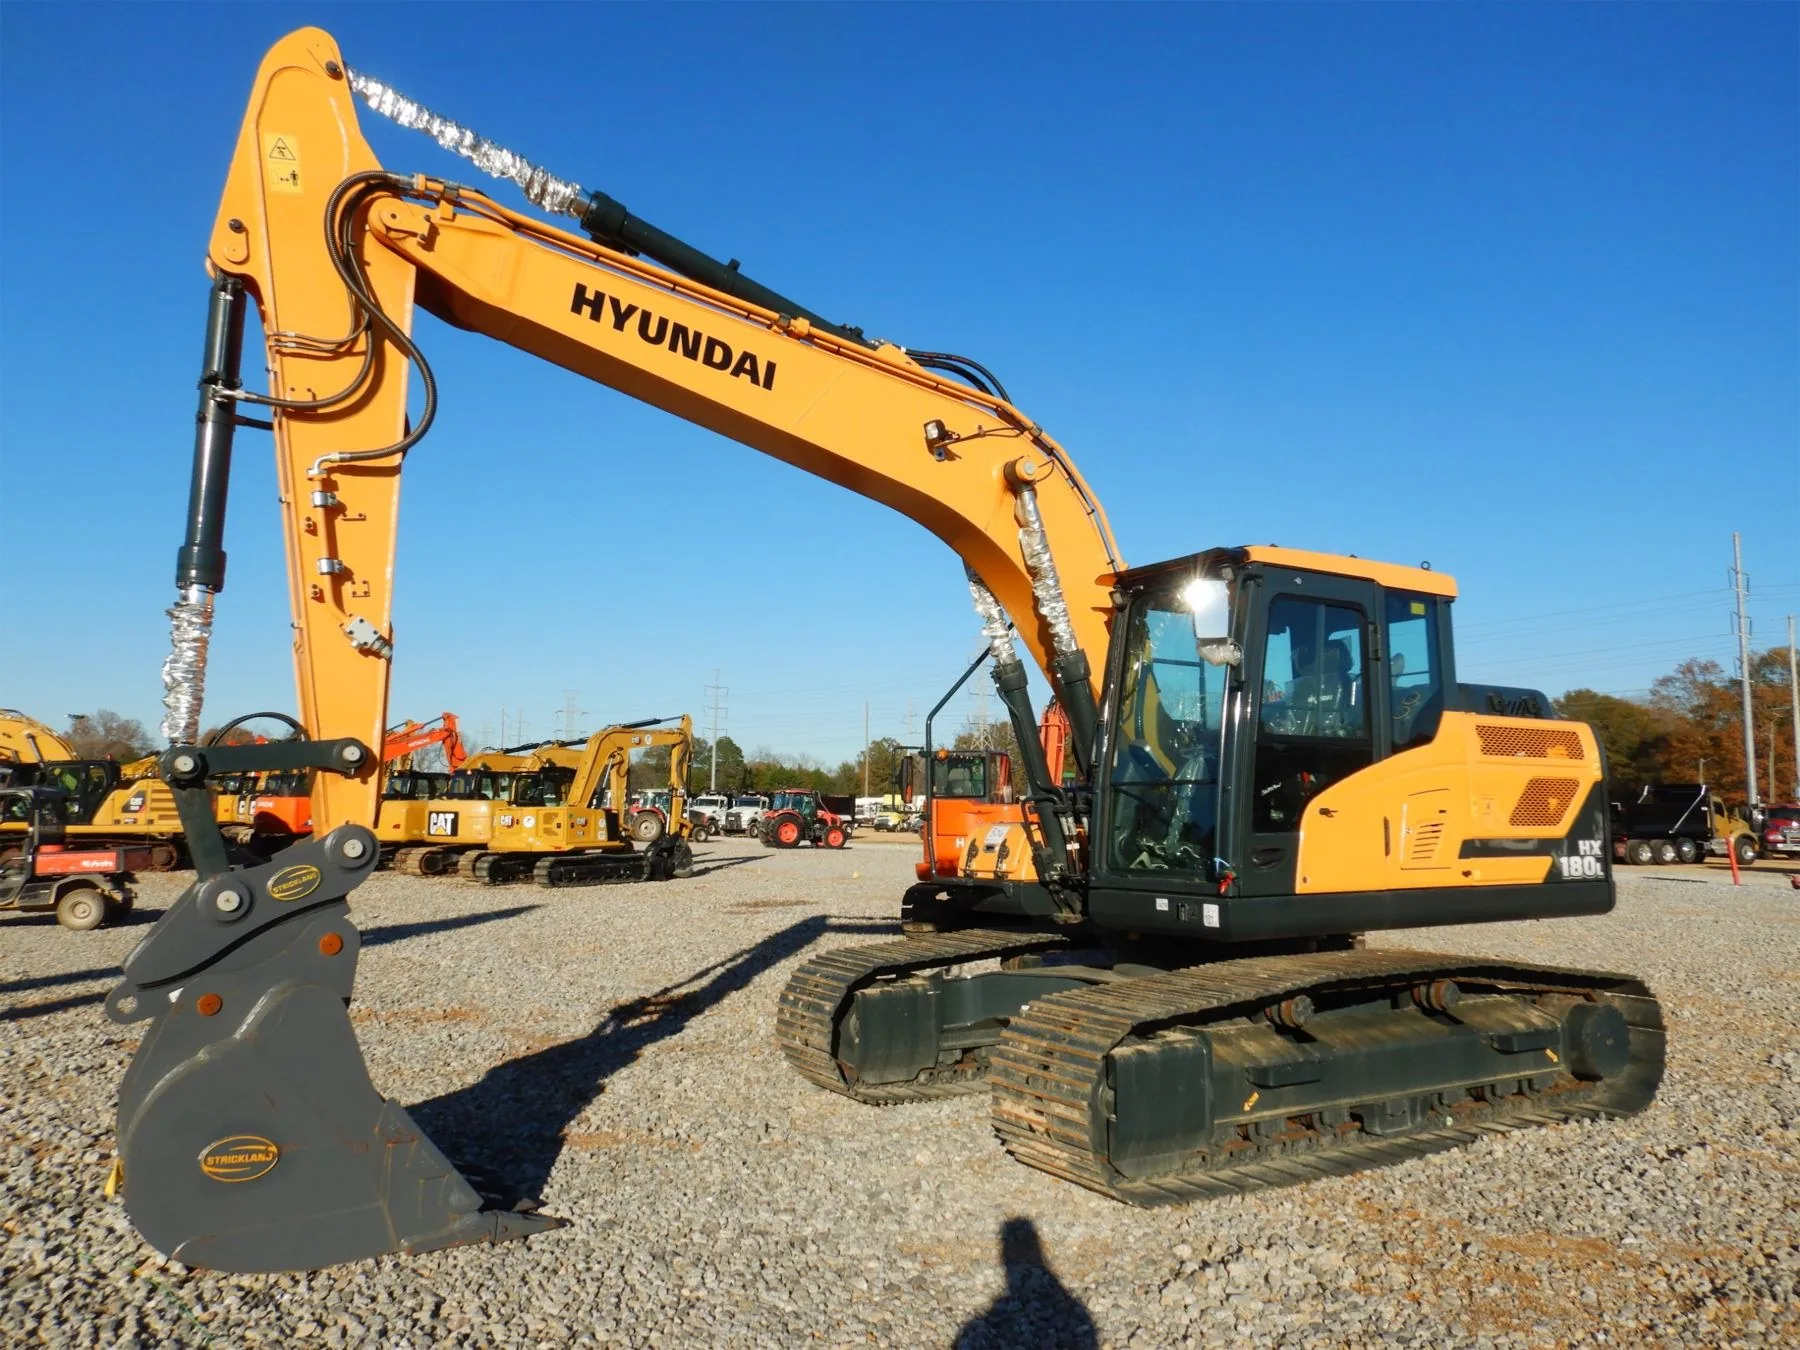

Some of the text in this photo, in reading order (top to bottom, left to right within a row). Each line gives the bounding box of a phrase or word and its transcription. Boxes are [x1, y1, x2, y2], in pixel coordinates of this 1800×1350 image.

[570, 281, 777, 391] HYUNDAI
[430, 812, 455, 835] CAT
[1578, 839, 1602, 856] HX
[272, 872, 317, 894] STRICKLAND
[206, 1153, 274, 1165] STRICKLAND
